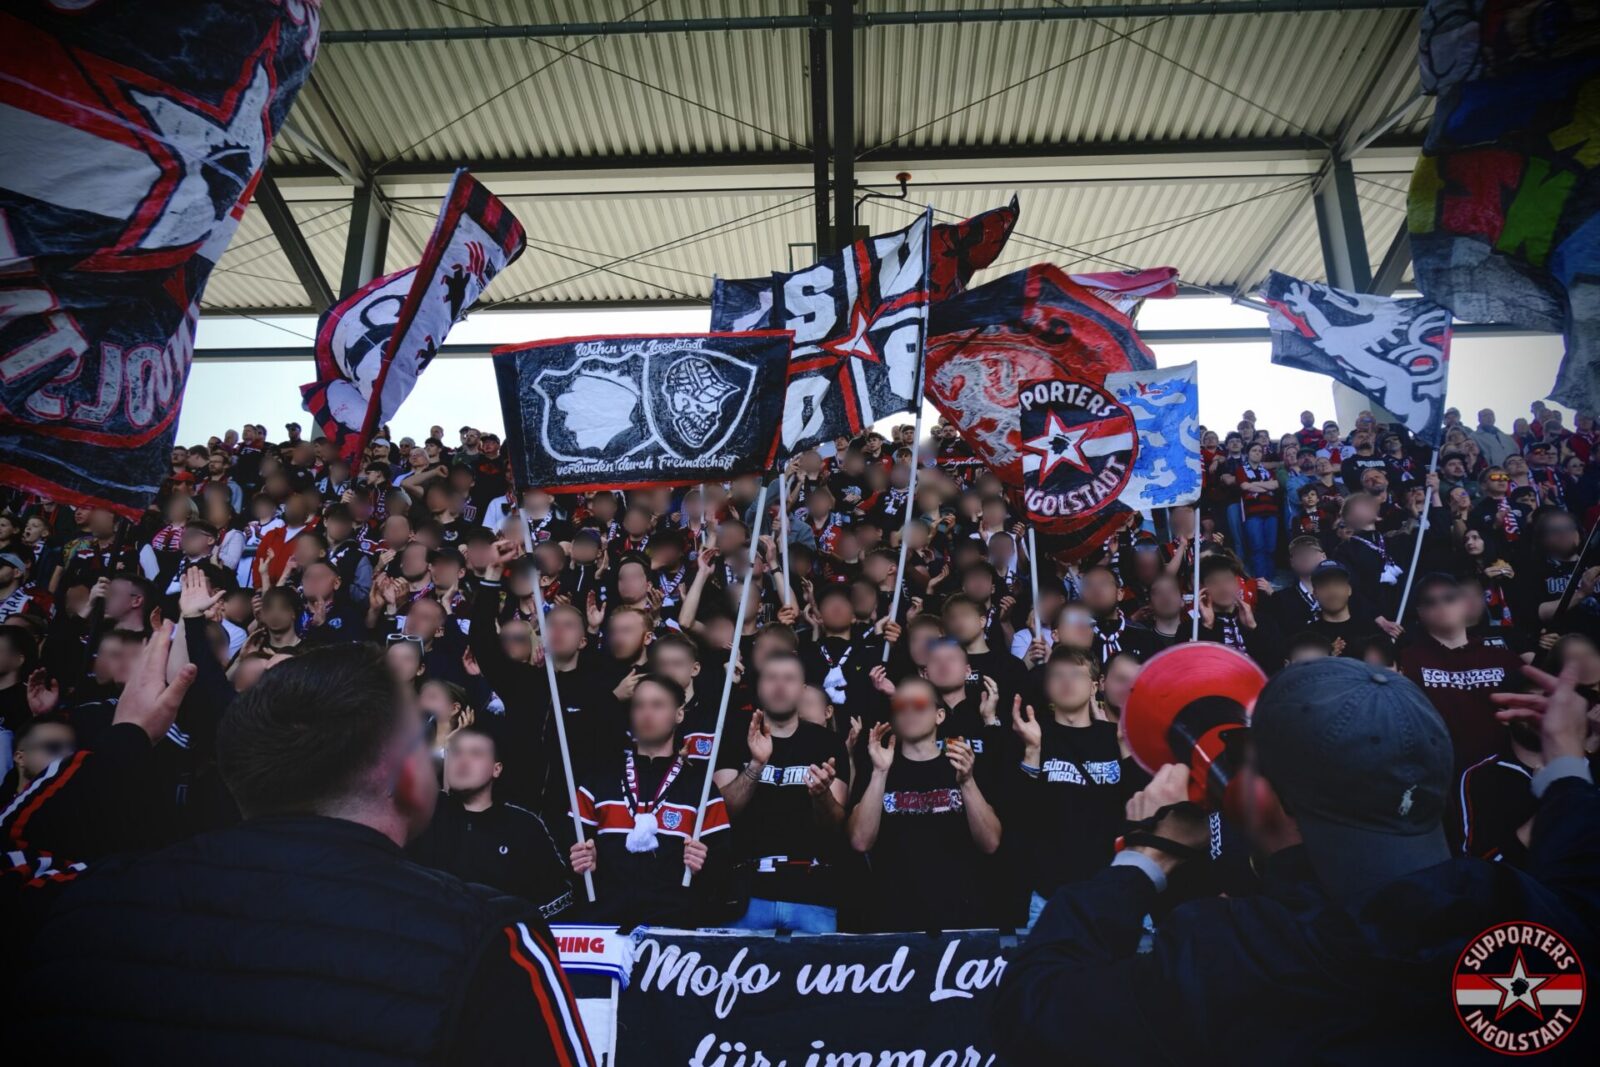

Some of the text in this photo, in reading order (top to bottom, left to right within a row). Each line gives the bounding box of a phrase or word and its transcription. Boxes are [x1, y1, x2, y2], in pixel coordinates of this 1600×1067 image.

[620, 341, 647, 353] und
[556, 454, 740, 476] verbunden durch Freundschaft
[634, 939, 780, 1019] Mofo
[796, 946, 915, 994] und
